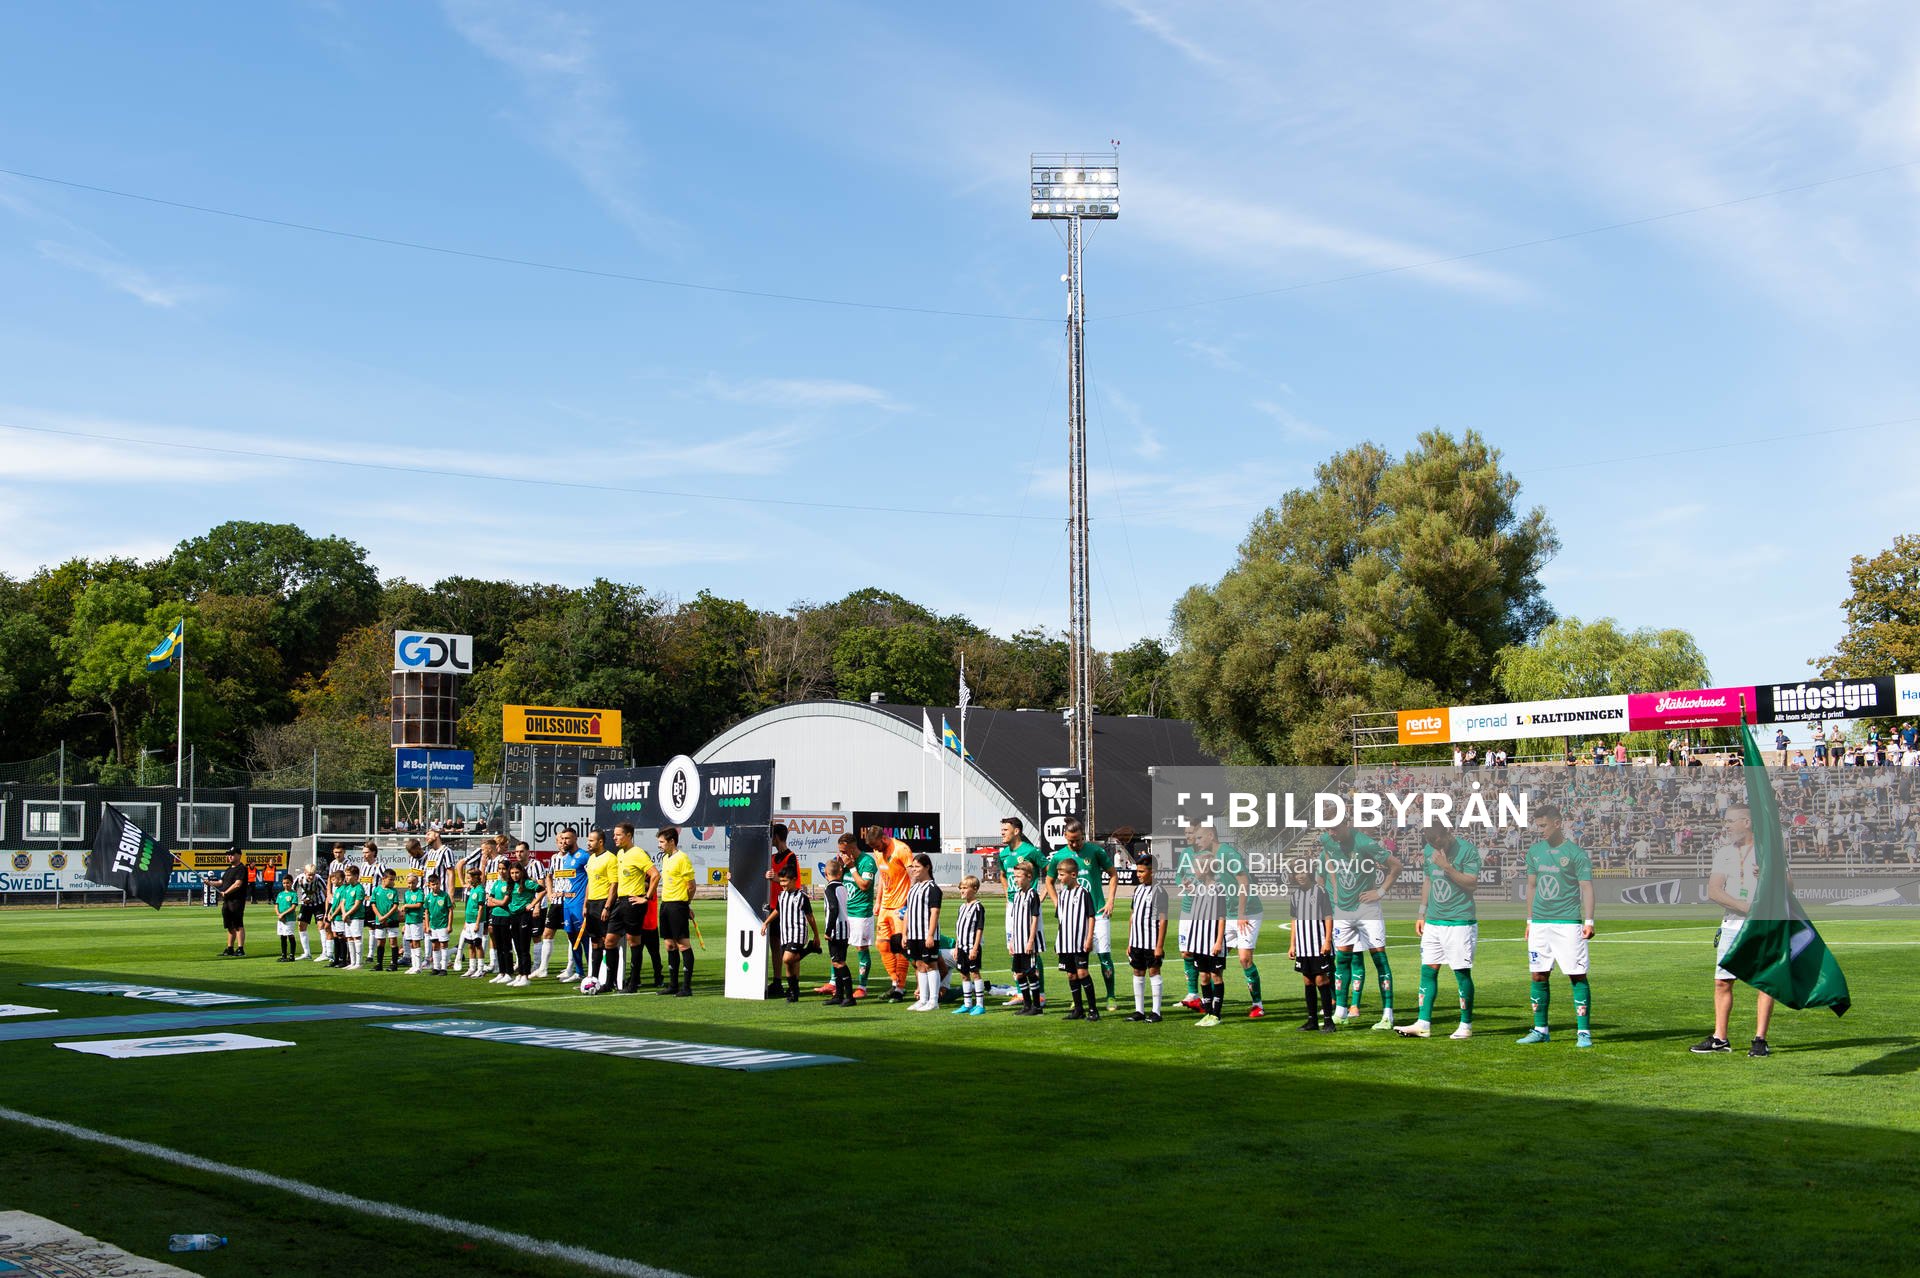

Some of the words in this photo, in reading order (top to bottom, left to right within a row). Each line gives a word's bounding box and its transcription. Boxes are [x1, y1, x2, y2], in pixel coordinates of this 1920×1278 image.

[399, 635, 469, 669] GDL
[1655, 696, 1726, 712] Mäklarhuset
[1772, 681, 1878, 712] infosign
[526, 717, 589, 734] OHLSSONS
[1406, 716, 1442, 731] renta
[1467, 713, 1507, 732] prenad
[411, 760, 465, 771] BorgWarner
[604, 781, 650, 800] UNIBET
[709, 775, 761, 796] UNIBET
[860, 825, 932, 840] HMAKVÄLL
[380, 854, 407, 866] kyrkan
[740, 930, 754, 958] U
